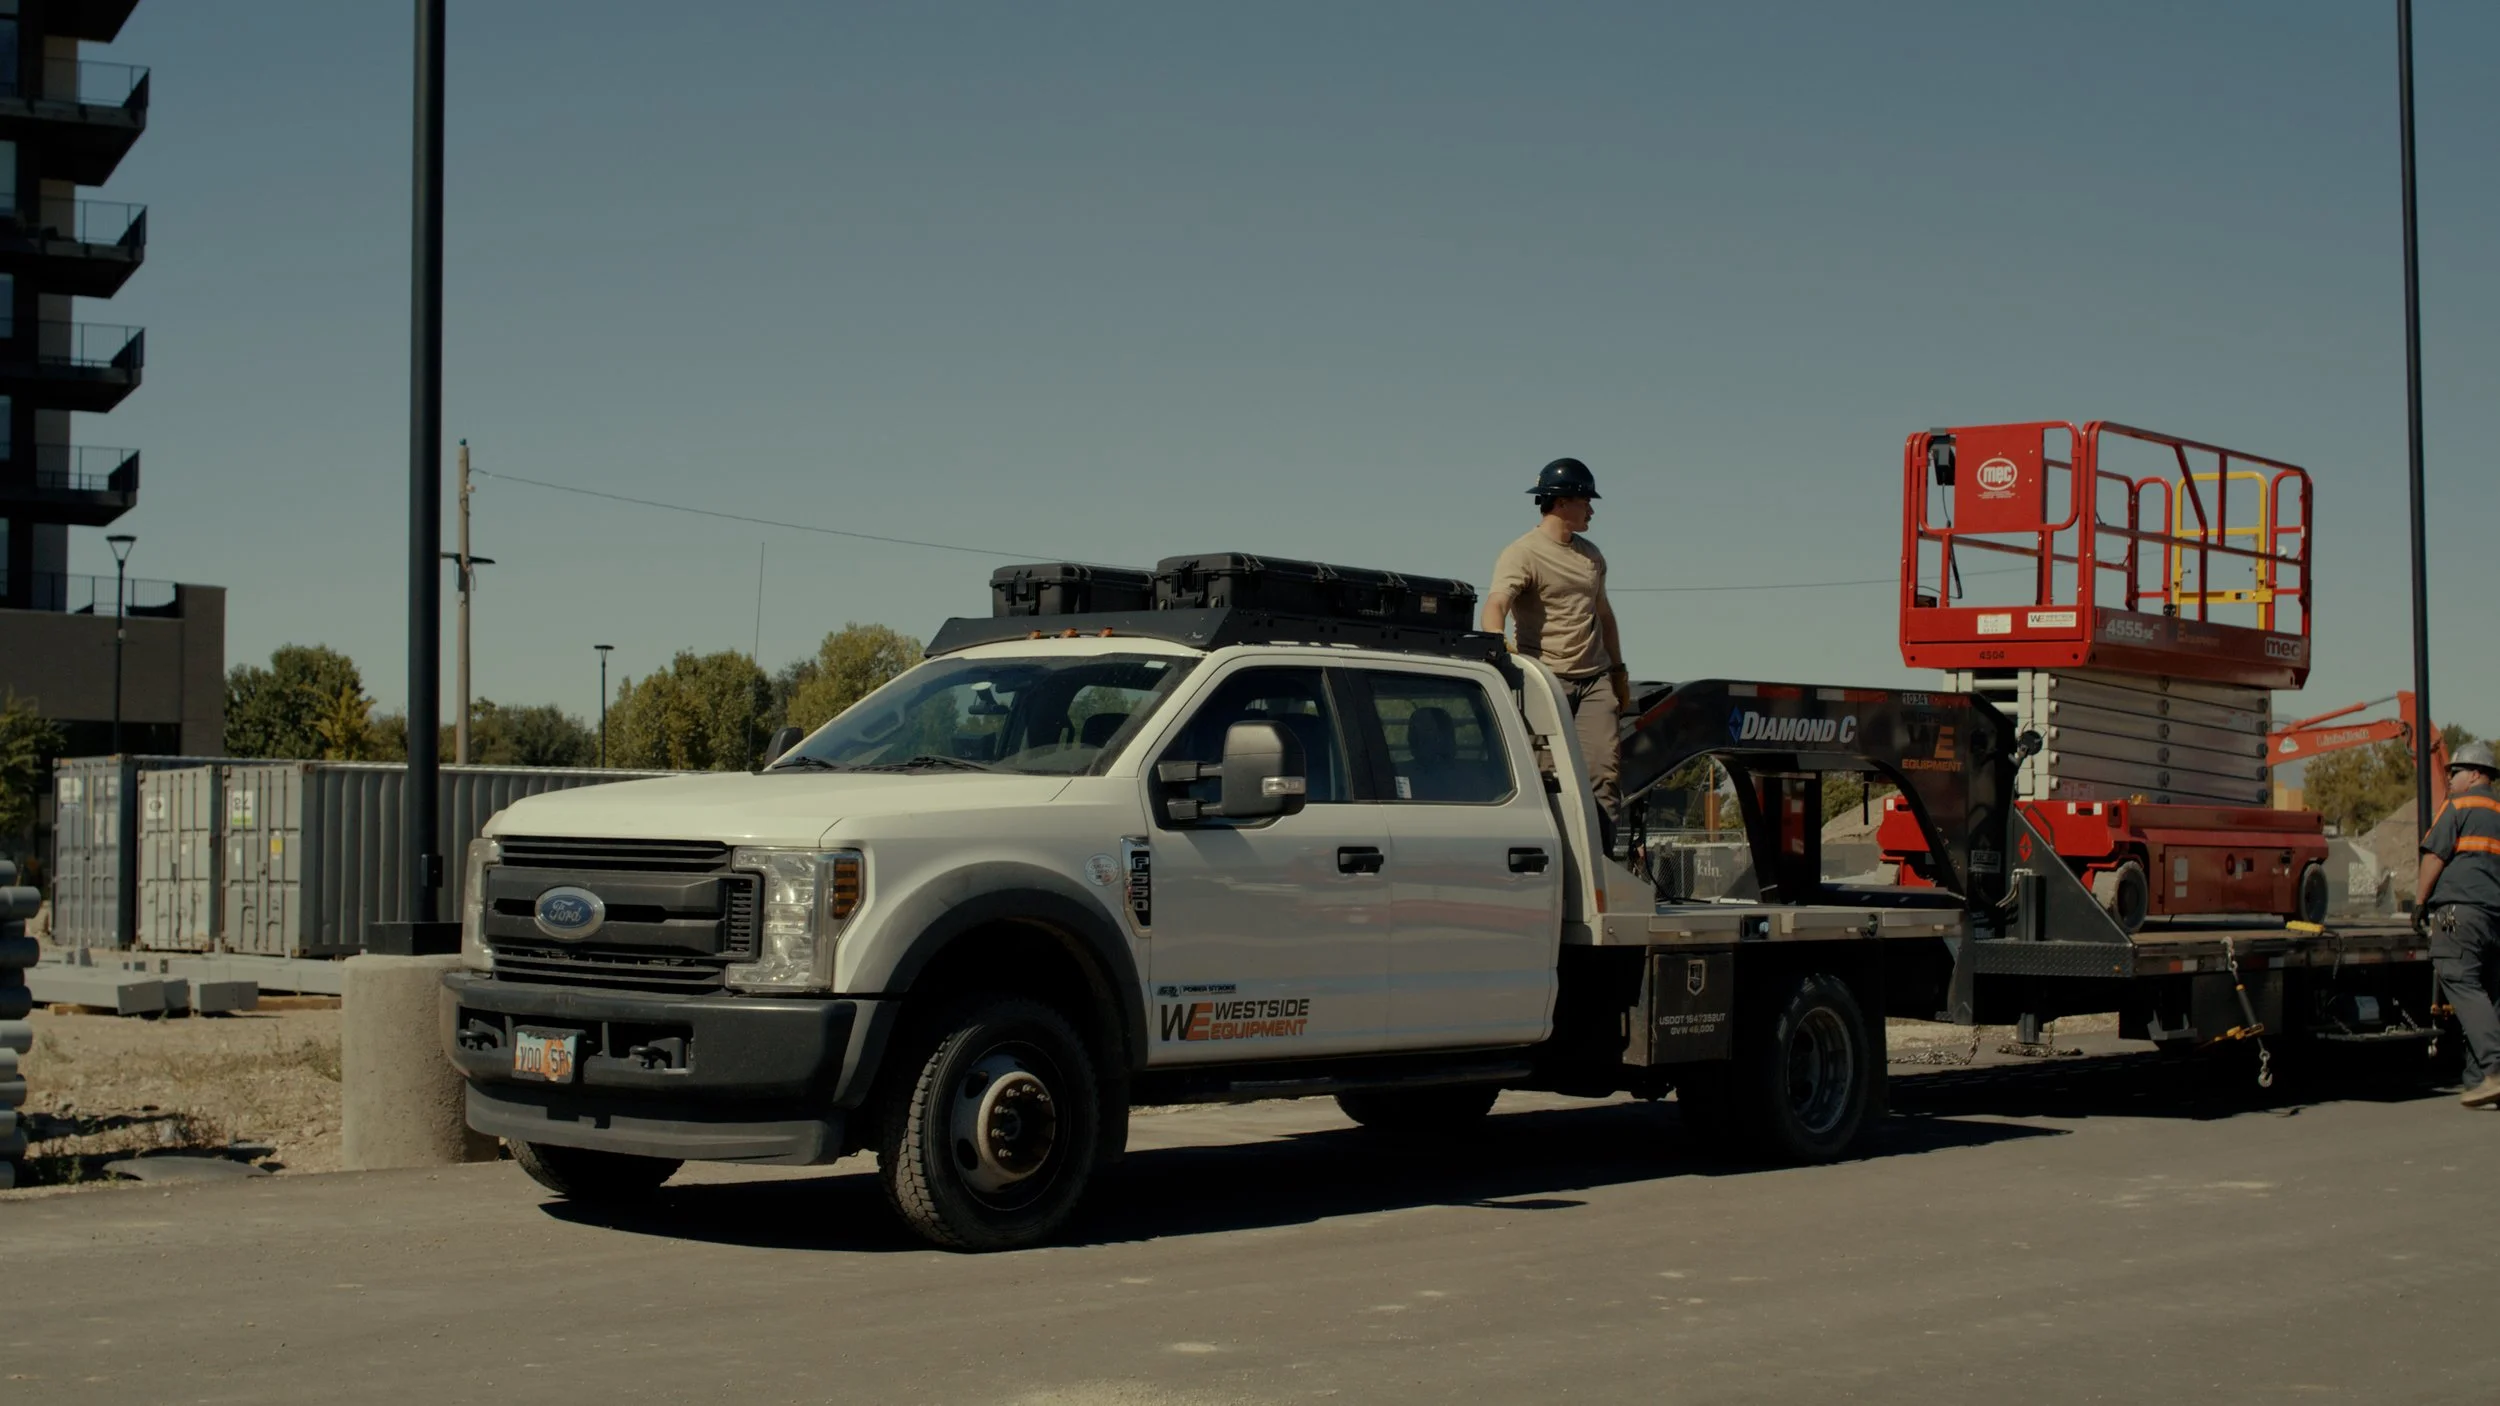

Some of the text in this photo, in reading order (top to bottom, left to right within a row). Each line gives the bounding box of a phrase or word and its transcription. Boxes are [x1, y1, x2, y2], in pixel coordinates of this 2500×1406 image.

[2266, 639, 2300, 658] mec
[1741, 710, 1857, 744] DIAMOND C
[1902, 758, 1963, 772] EQUIPMENT
[550, 900, 582, 924] Ford
[1215, 999, 1310, 1020] WESTSIDE
[1659, 1015, 1684, 1025] USDOT
[1161, 1002, 1213, 1041] WE
[1211, 1018, 1308, 1040] EQUIPMENT
